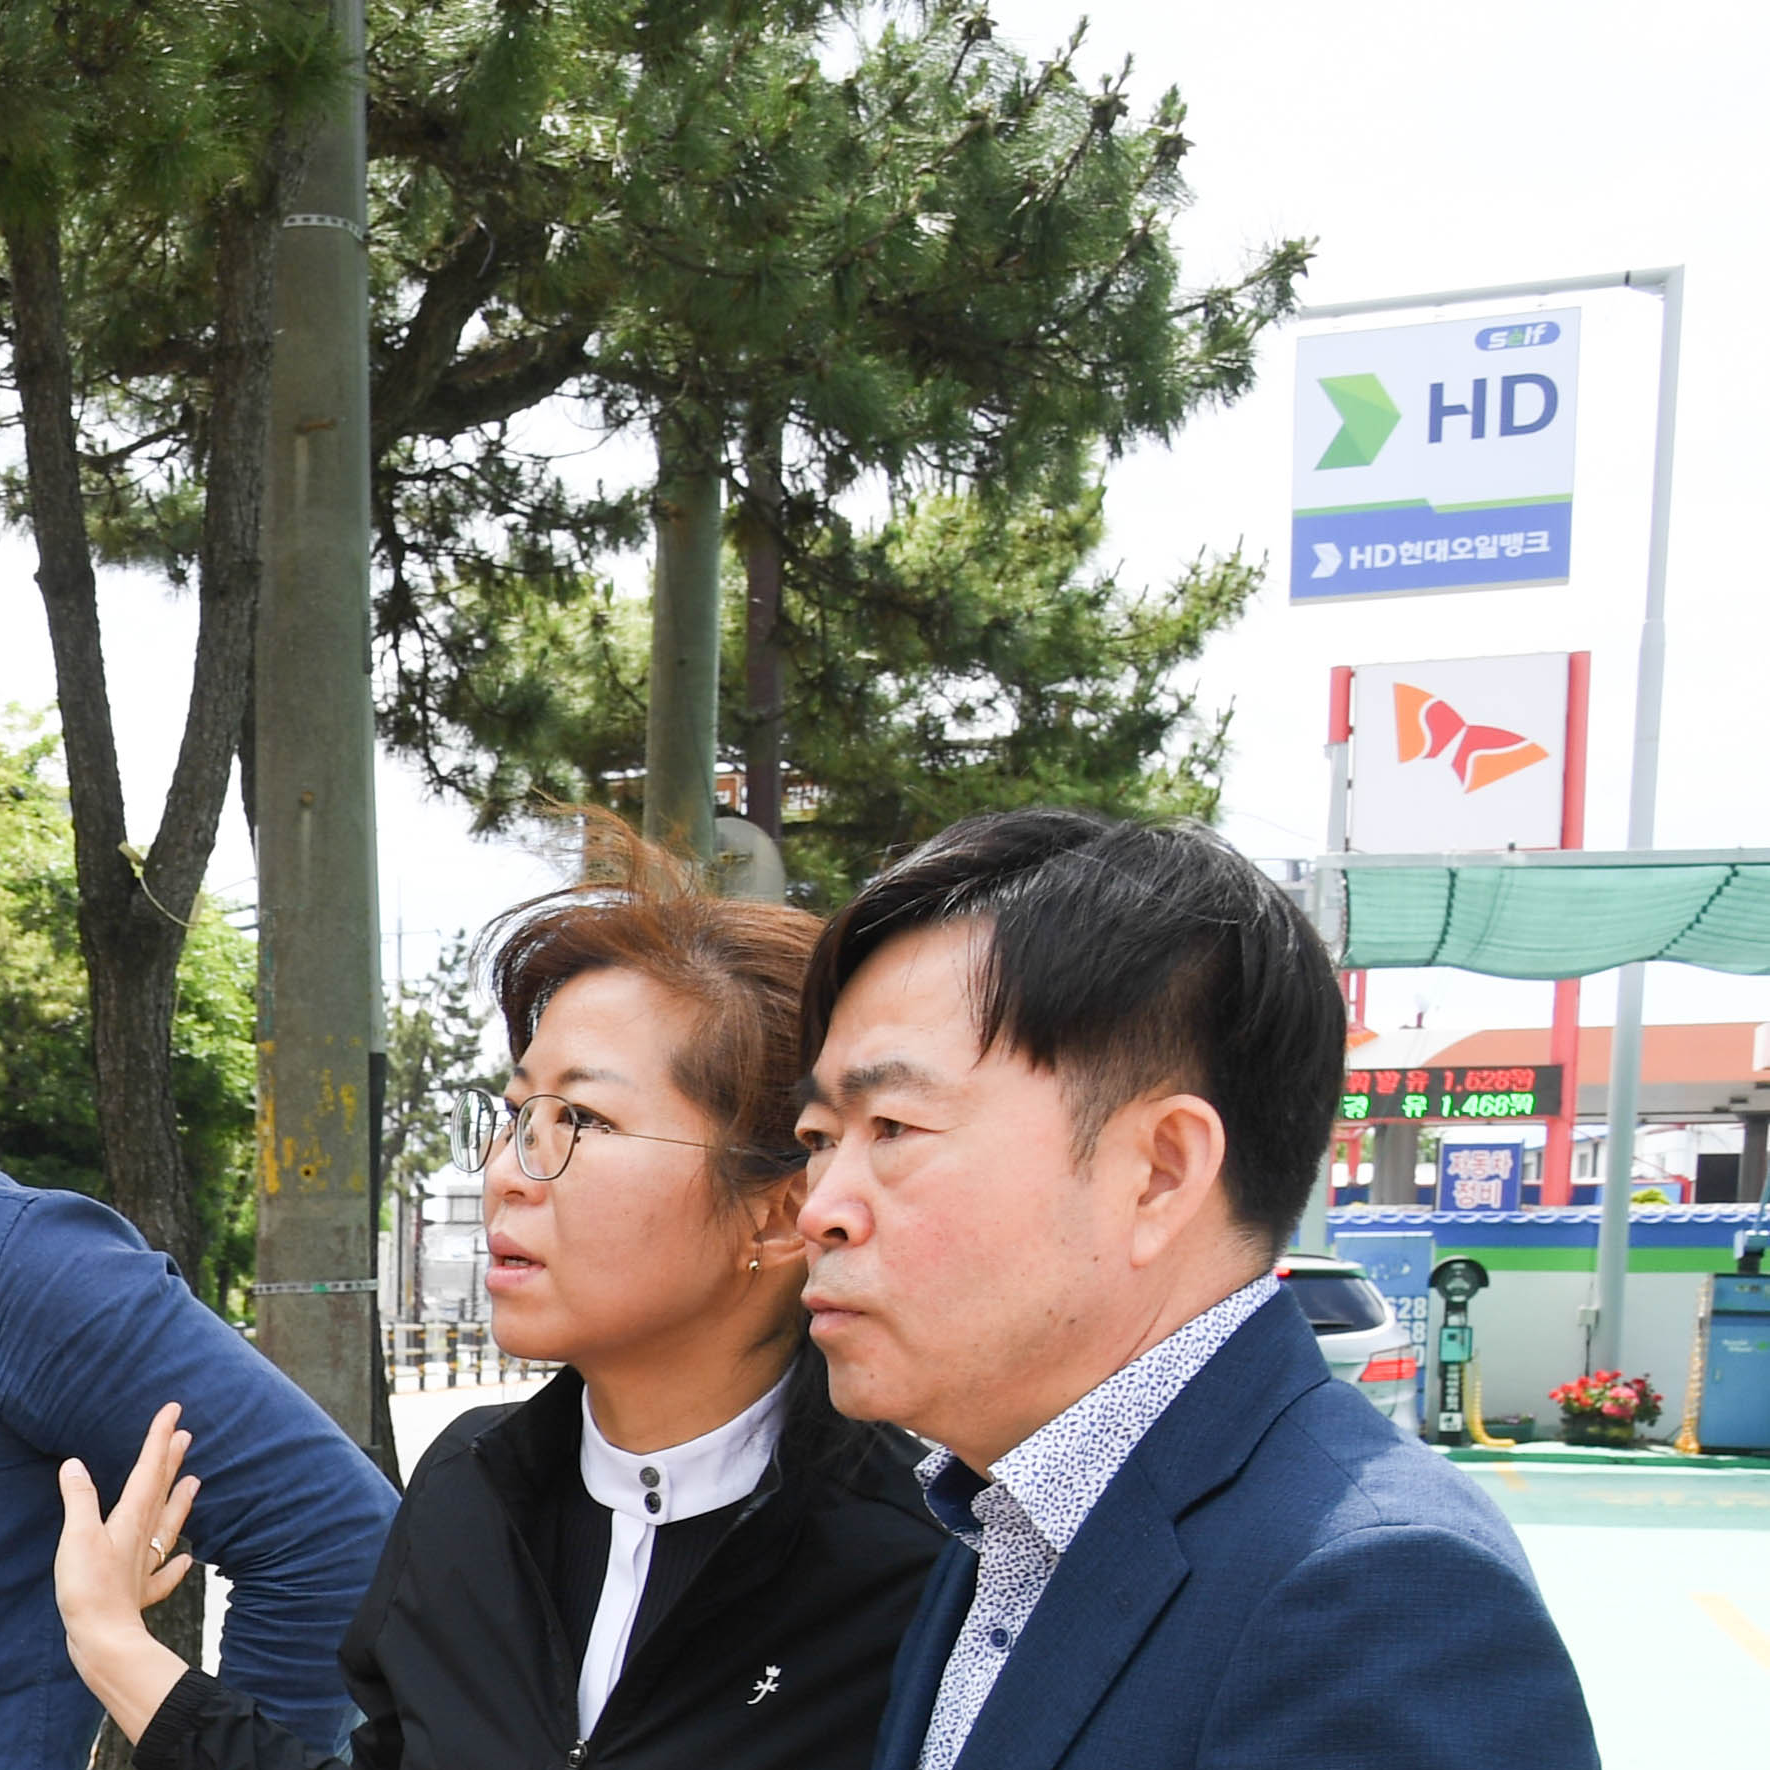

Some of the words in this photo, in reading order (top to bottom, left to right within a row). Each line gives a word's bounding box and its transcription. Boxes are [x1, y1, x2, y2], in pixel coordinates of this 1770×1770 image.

[1427, 372, 1560, 444] HD
[1349, 531, 1551, 571] HD현대오일뱅크
[1447, 1150, 1513, 1180] 자동차
[1453, 1179, 1503, 1208] 정비
